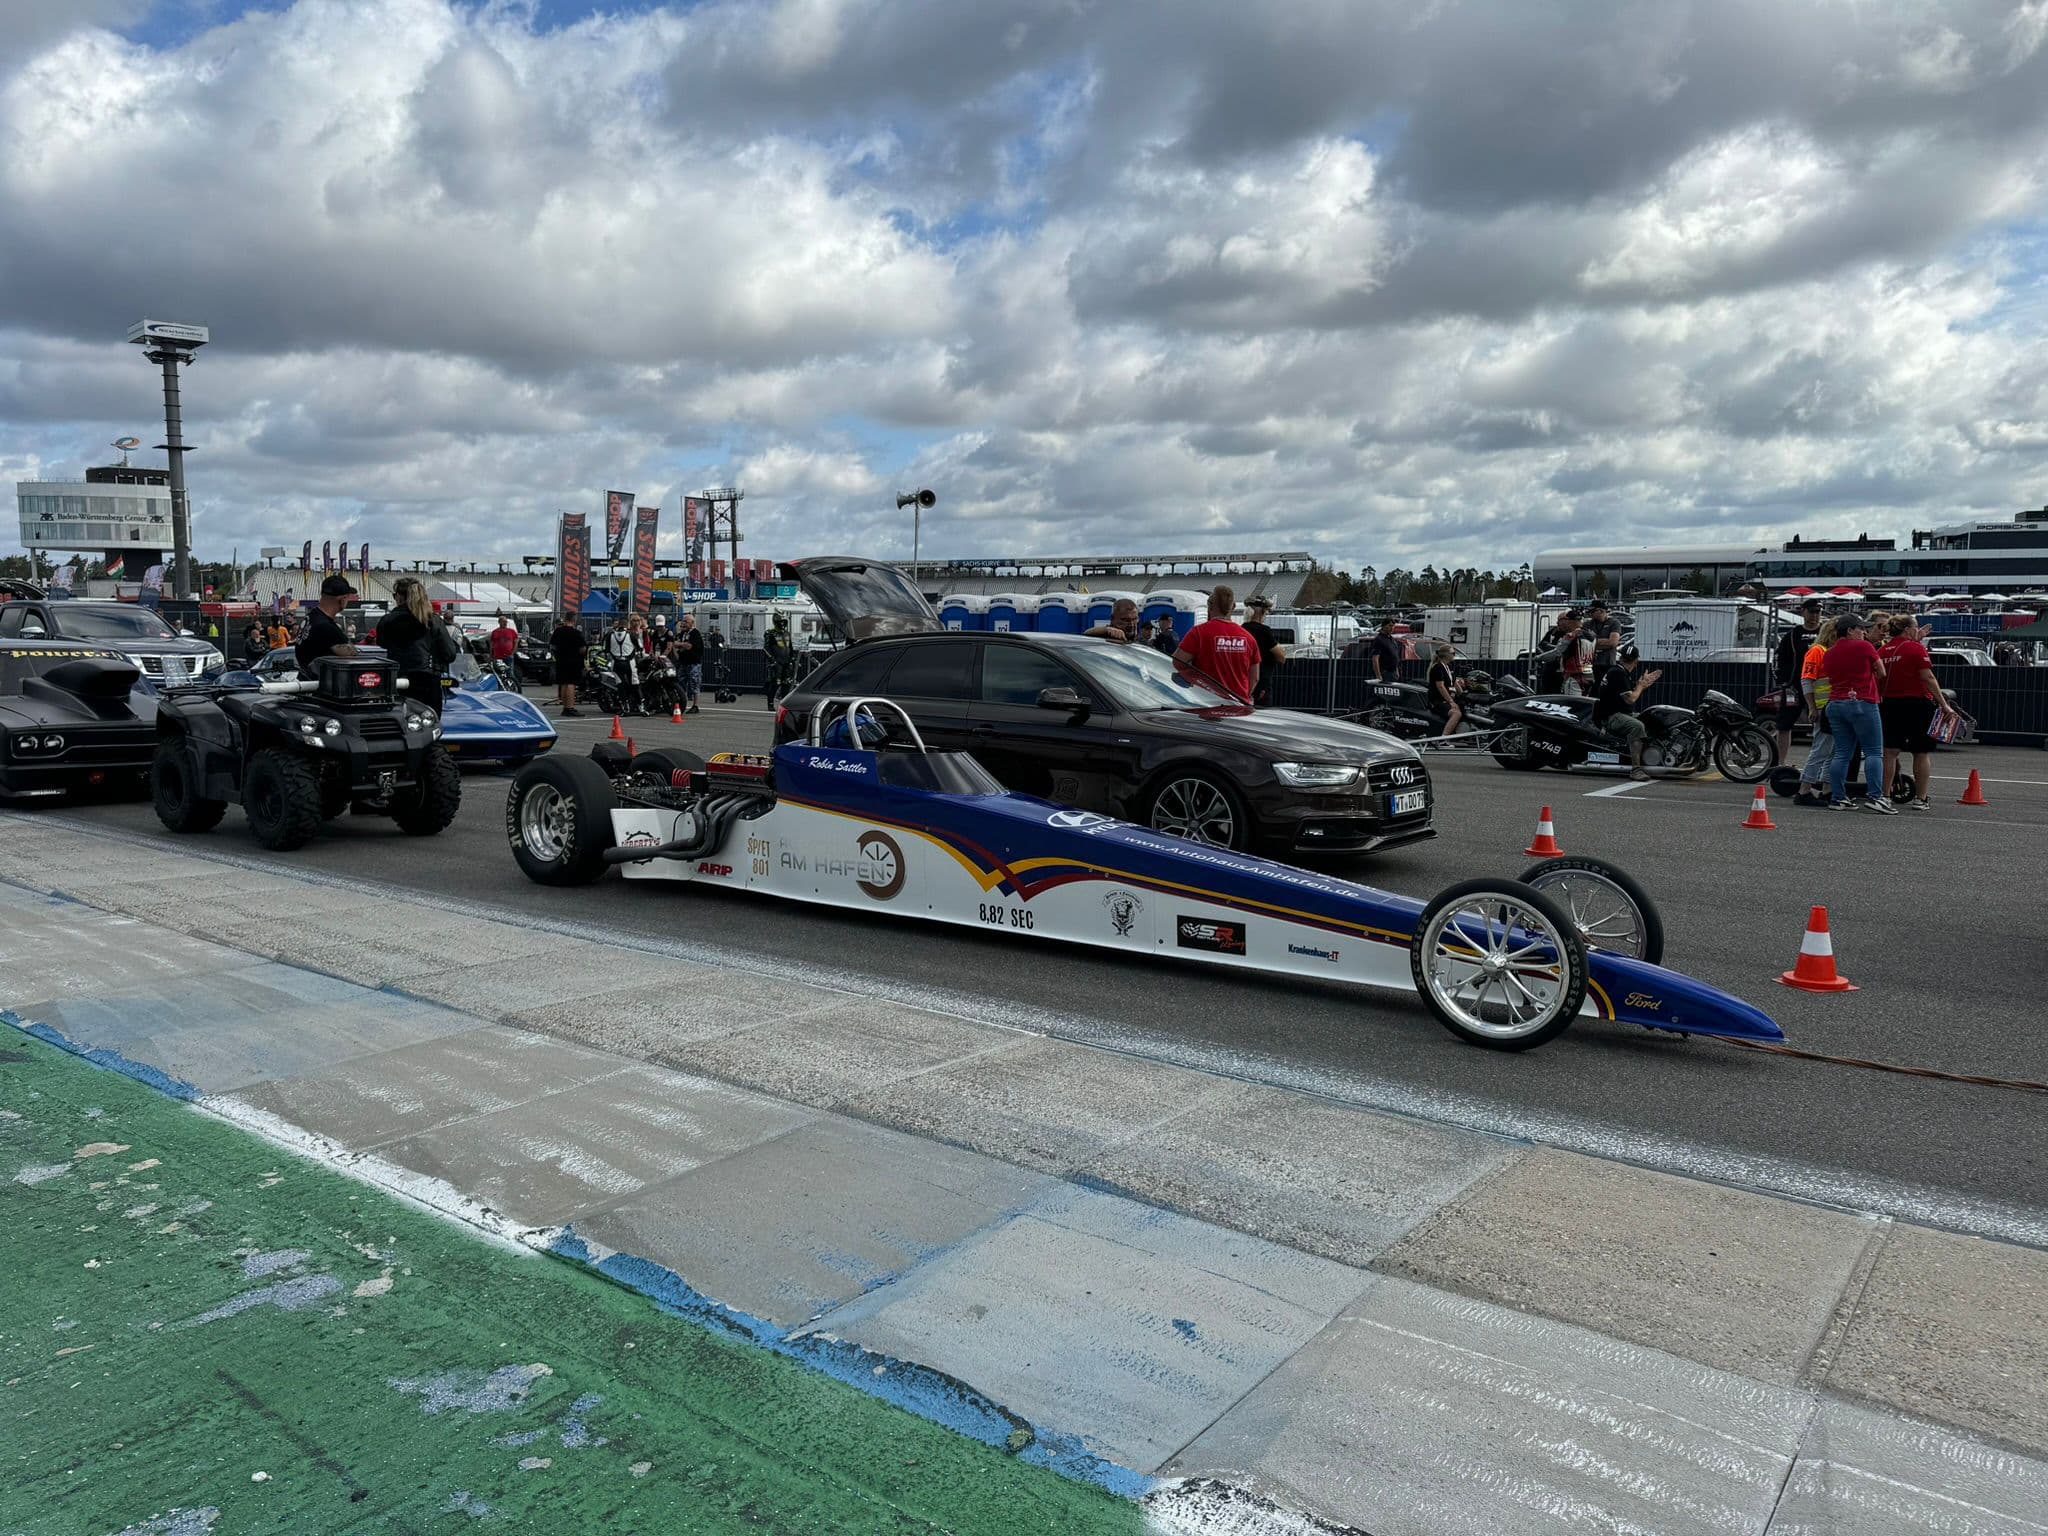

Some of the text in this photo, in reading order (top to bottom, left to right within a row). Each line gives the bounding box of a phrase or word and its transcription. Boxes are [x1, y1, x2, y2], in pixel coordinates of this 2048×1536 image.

[57, 512, 123, 522] Baden-Württemberg
[1542, 741, 1562, 755] 749
[808, 756, 868, 774] Robin Sattler
[747, 837, 770, 858] SP/ET
[698, 862, 733, 876] ARP
[752, 858, 770, 876] 801
[780, 852, 886, 881] AM HAFEN
[979, 903, 1034, 930] 8,82 SEC
[1199, 924, 1234, 941] SR
[1624, 992, 1663, 1011] Ford
